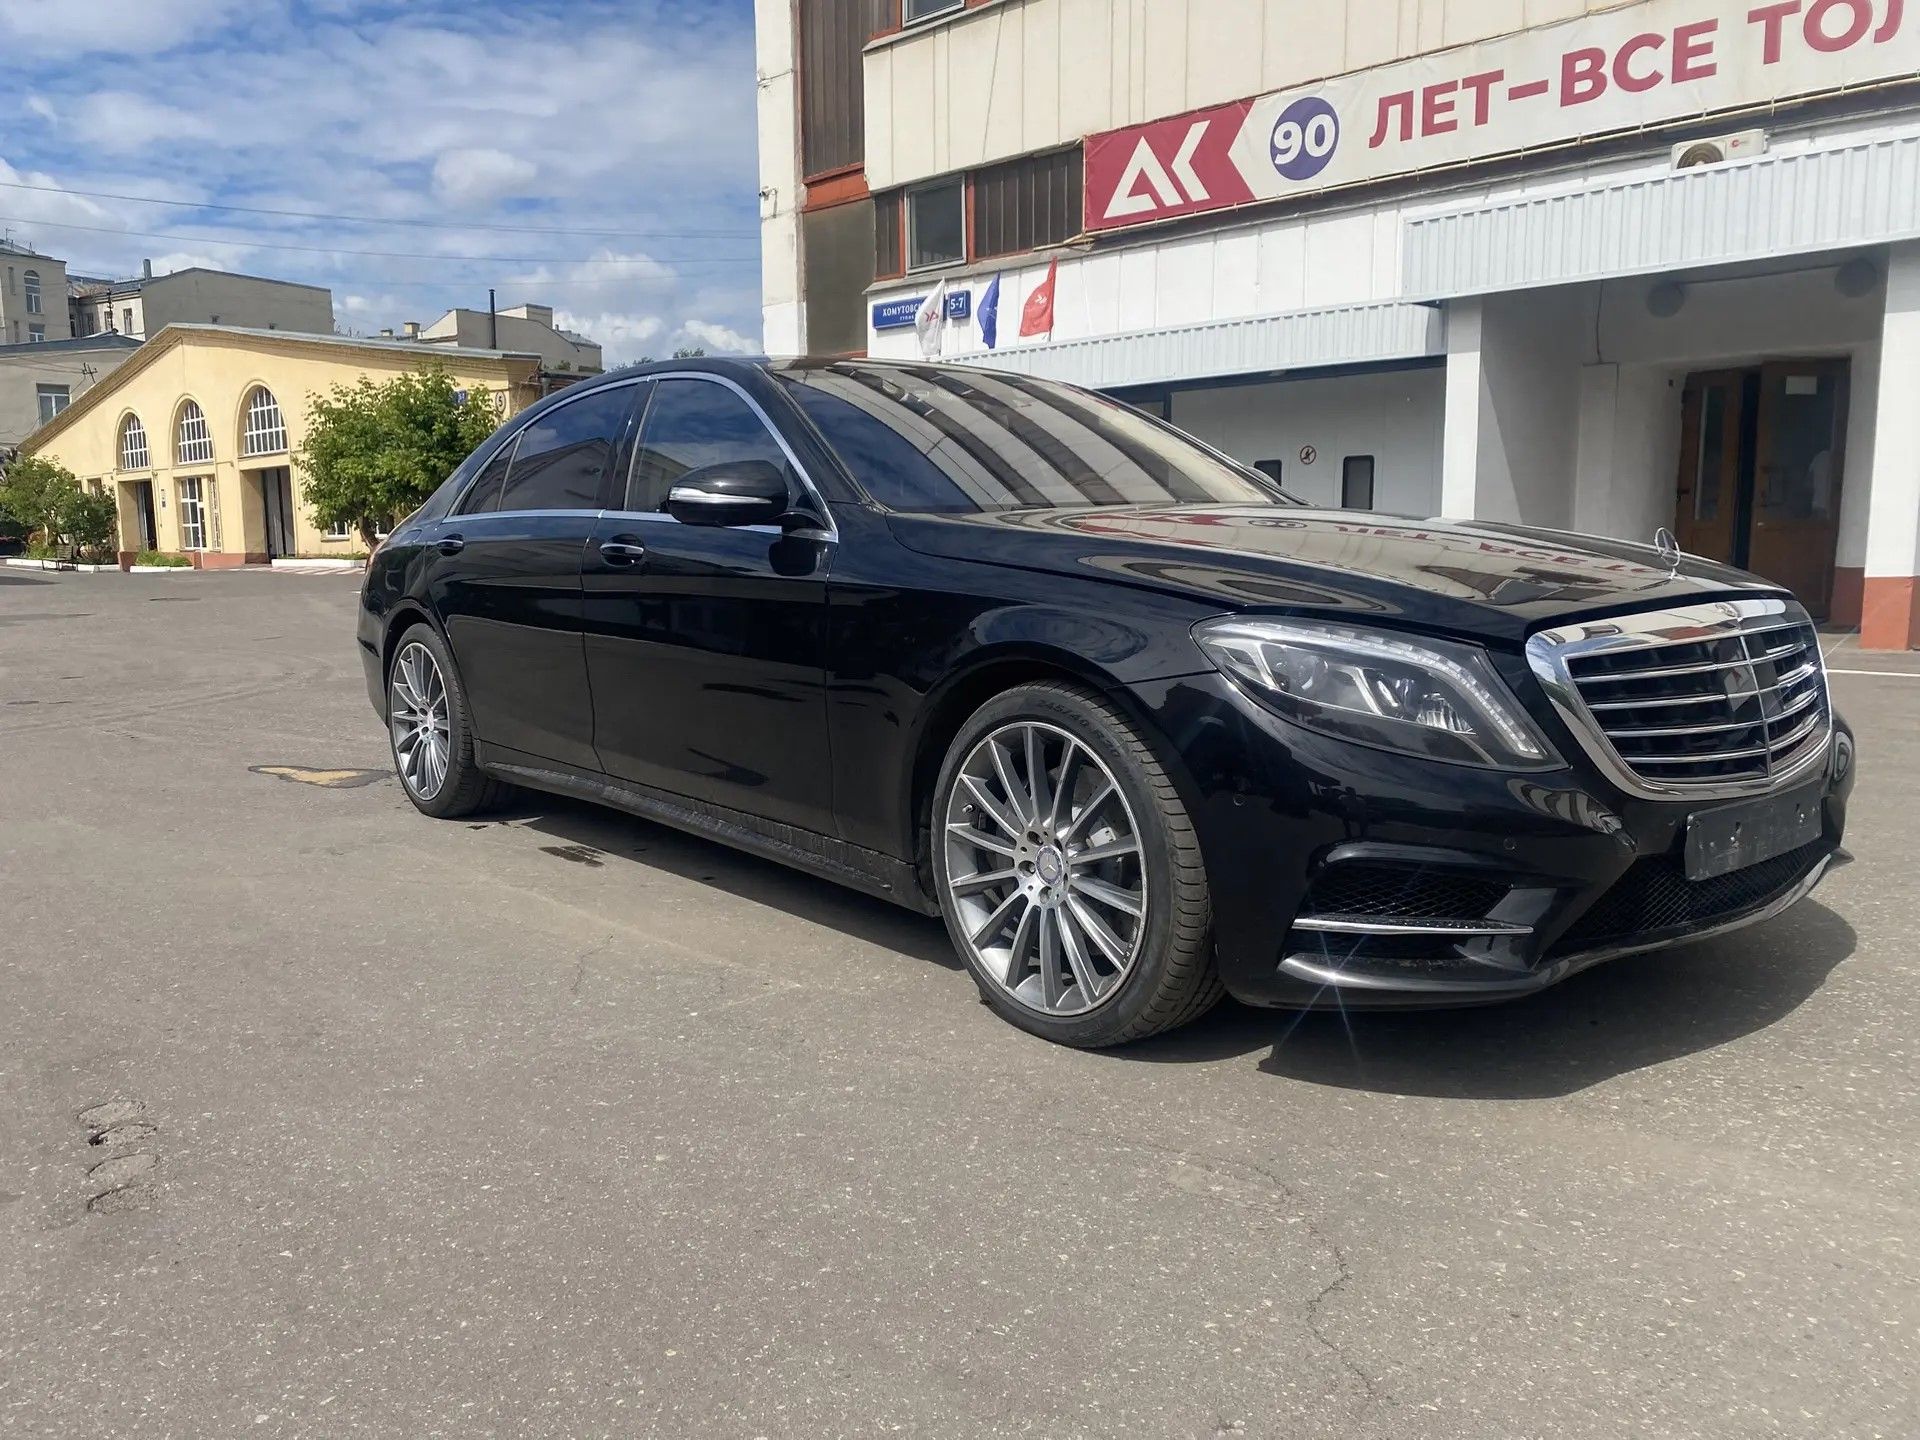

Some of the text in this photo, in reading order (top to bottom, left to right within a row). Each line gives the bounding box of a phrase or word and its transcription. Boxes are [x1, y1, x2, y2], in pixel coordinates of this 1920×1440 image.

[1273, 113, 1336, 165] 90
[882, 303, 920, 317] ХОМУТОВС
[950, 297, 964, 310] 5-7
